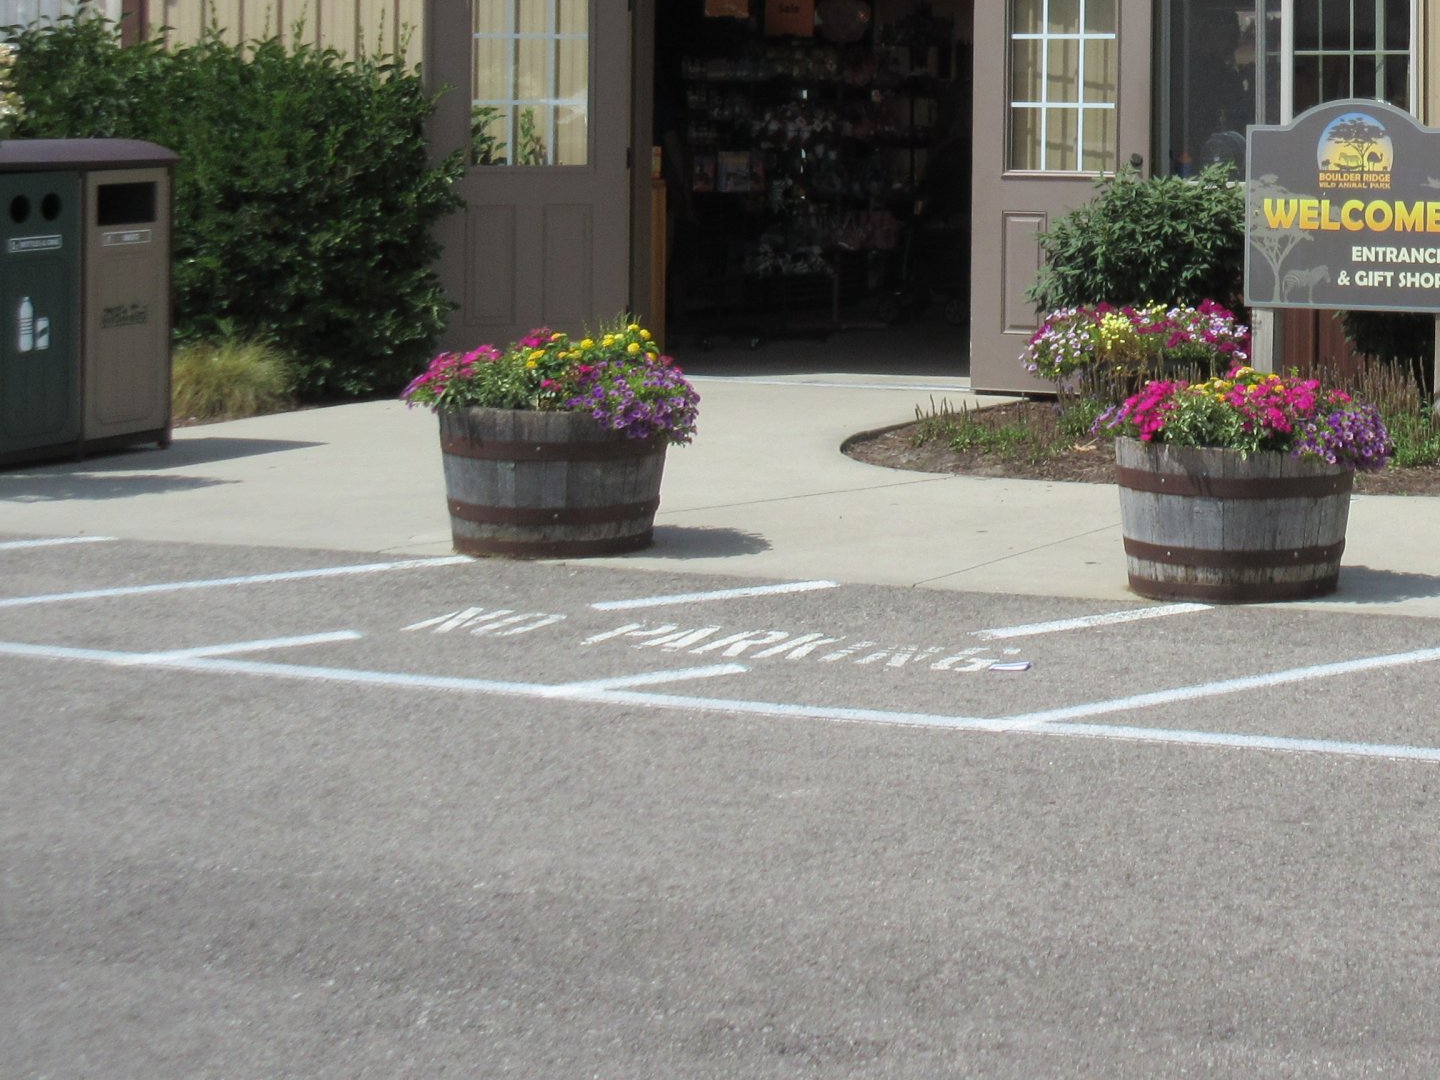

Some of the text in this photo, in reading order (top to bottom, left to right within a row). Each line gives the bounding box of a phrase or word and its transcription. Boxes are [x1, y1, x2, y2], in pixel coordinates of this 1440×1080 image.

[777, 3, 800, 14] Sale
[1319, 172, 1391, 183] BOULDER RIDGE
[1337, 270, 1350, 286] &
[1354, 271, 1394, 287] GIFT
[400, 606, 568, 637] NO
